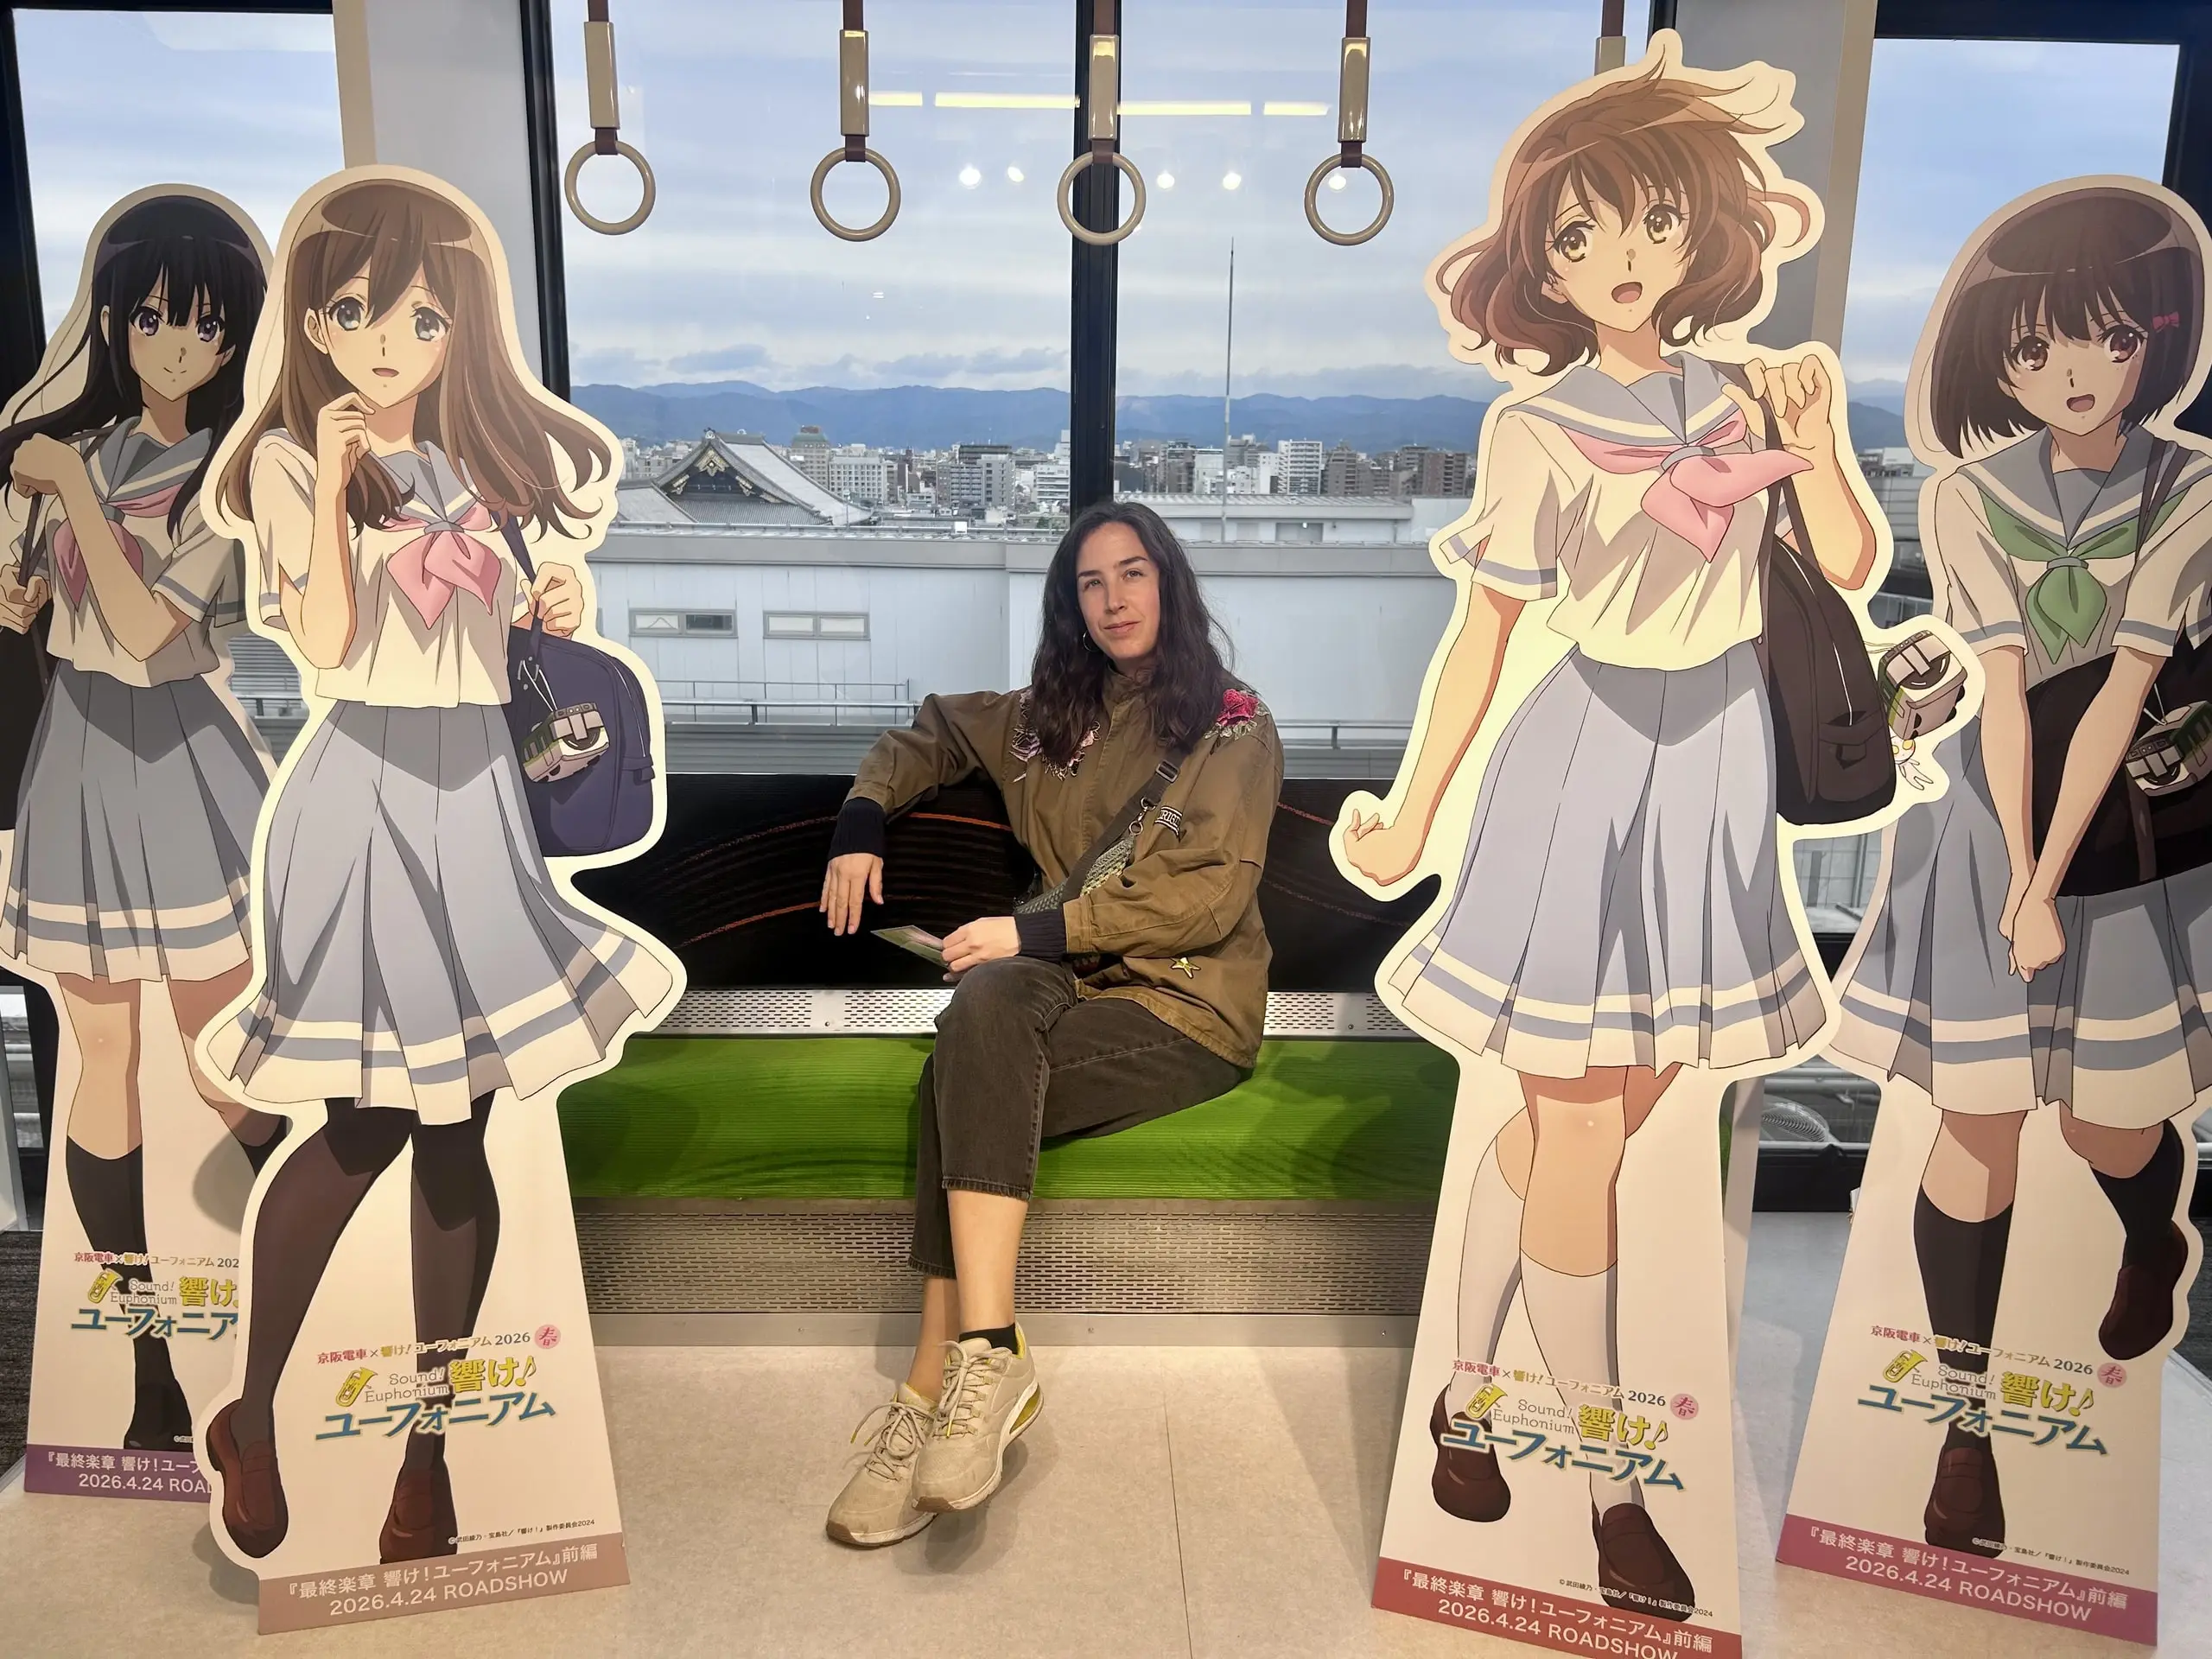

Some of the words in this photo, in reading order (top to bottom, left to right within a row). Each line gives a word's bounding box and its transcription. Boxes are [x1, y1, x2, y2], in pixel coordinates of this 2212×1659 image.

[130, 1279, 175, 1292] Sound!
[111, 1292, 177, 1305] Euphonium
[71, 1308, 239, 1340] ユーフォニア
[494, 1332, 531, 1346] 2026
[389, 1366, 446, 1386] Sound!
[1937, 1363, 1995, 1385] Sound!
[2053, 1358, 2094, 1375] 2026
[365, 1384, 449, 1403] Euphonium
[1628, 1389, 1666, 1408] 2026
[1910, 1374, 1997, 1401] Euphonium
[315, 1391, 557, 1440] ユーフォニアム
[1517, 1398, 1573, 1420] Sound!
[1857, 1384, 2108, 1456] ユーフォニアム
[1492, 1408, 1575, 1435] Euphonium
[1442, 1421, 1685, 1491] ユーフォニアム
[79, 1473, 164, 1491] 2026.4.24
[329, 1587, 437, 1617] 2026.4.24
[443, 1568, 569, 1600] ROADSHOW
[1845, 1555, 1952, 1592] 2026.4.24
[1959, 1582, 2092, 1622] ROADSHOW
[1438, 1599, 1541, 1635] 2026.4.24
[1548, 1626, 1678, 1659] ROADSHOW
